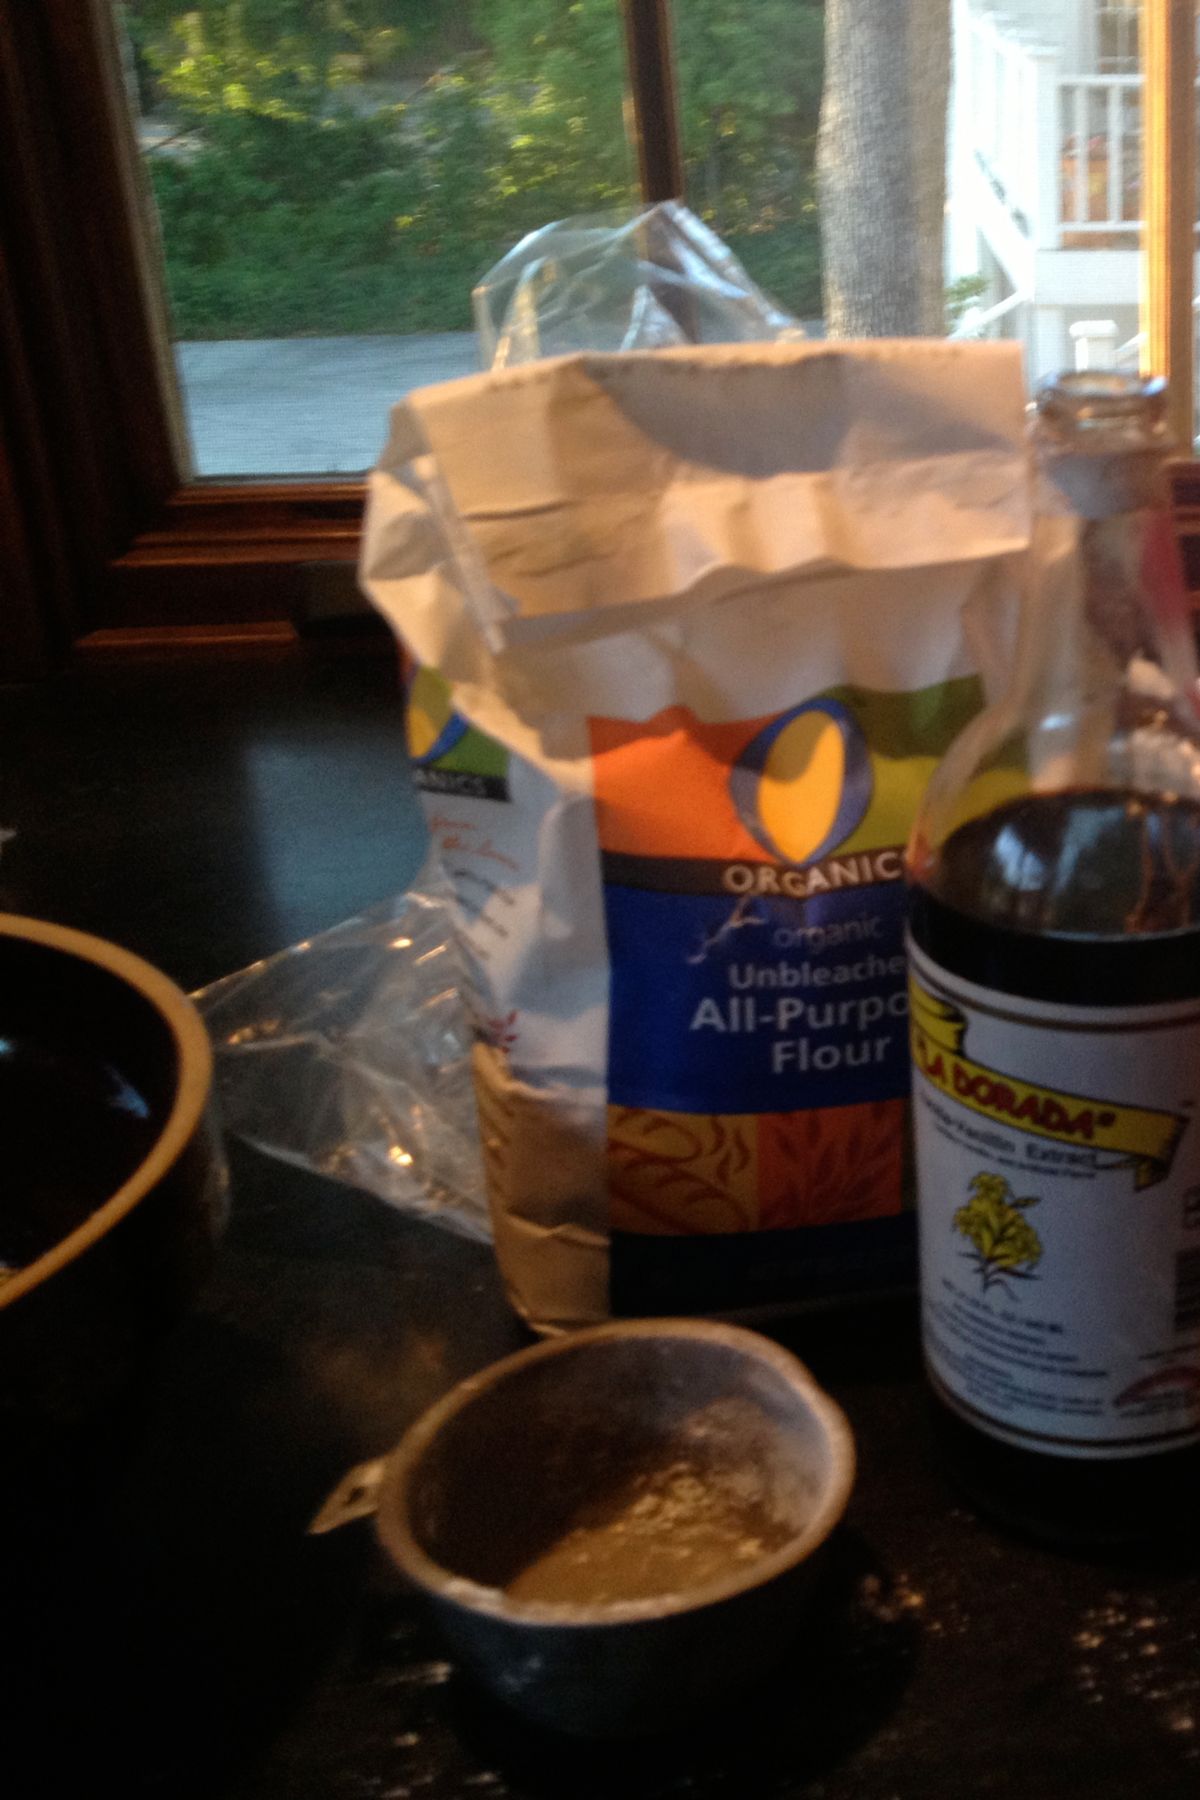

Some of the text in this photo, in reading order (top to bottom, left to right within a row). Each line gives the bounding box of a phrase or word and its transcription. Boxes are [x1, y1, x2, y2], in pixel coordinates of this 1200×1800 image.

[722, 851, 904, 896] ORGANIC
[773, 912, 882, 953] organic
[729, 954, 906, 990] Unbleache
[690, 991, 911, 1033] All-Purpo
[771, 1036, 892, 1075] Flour
